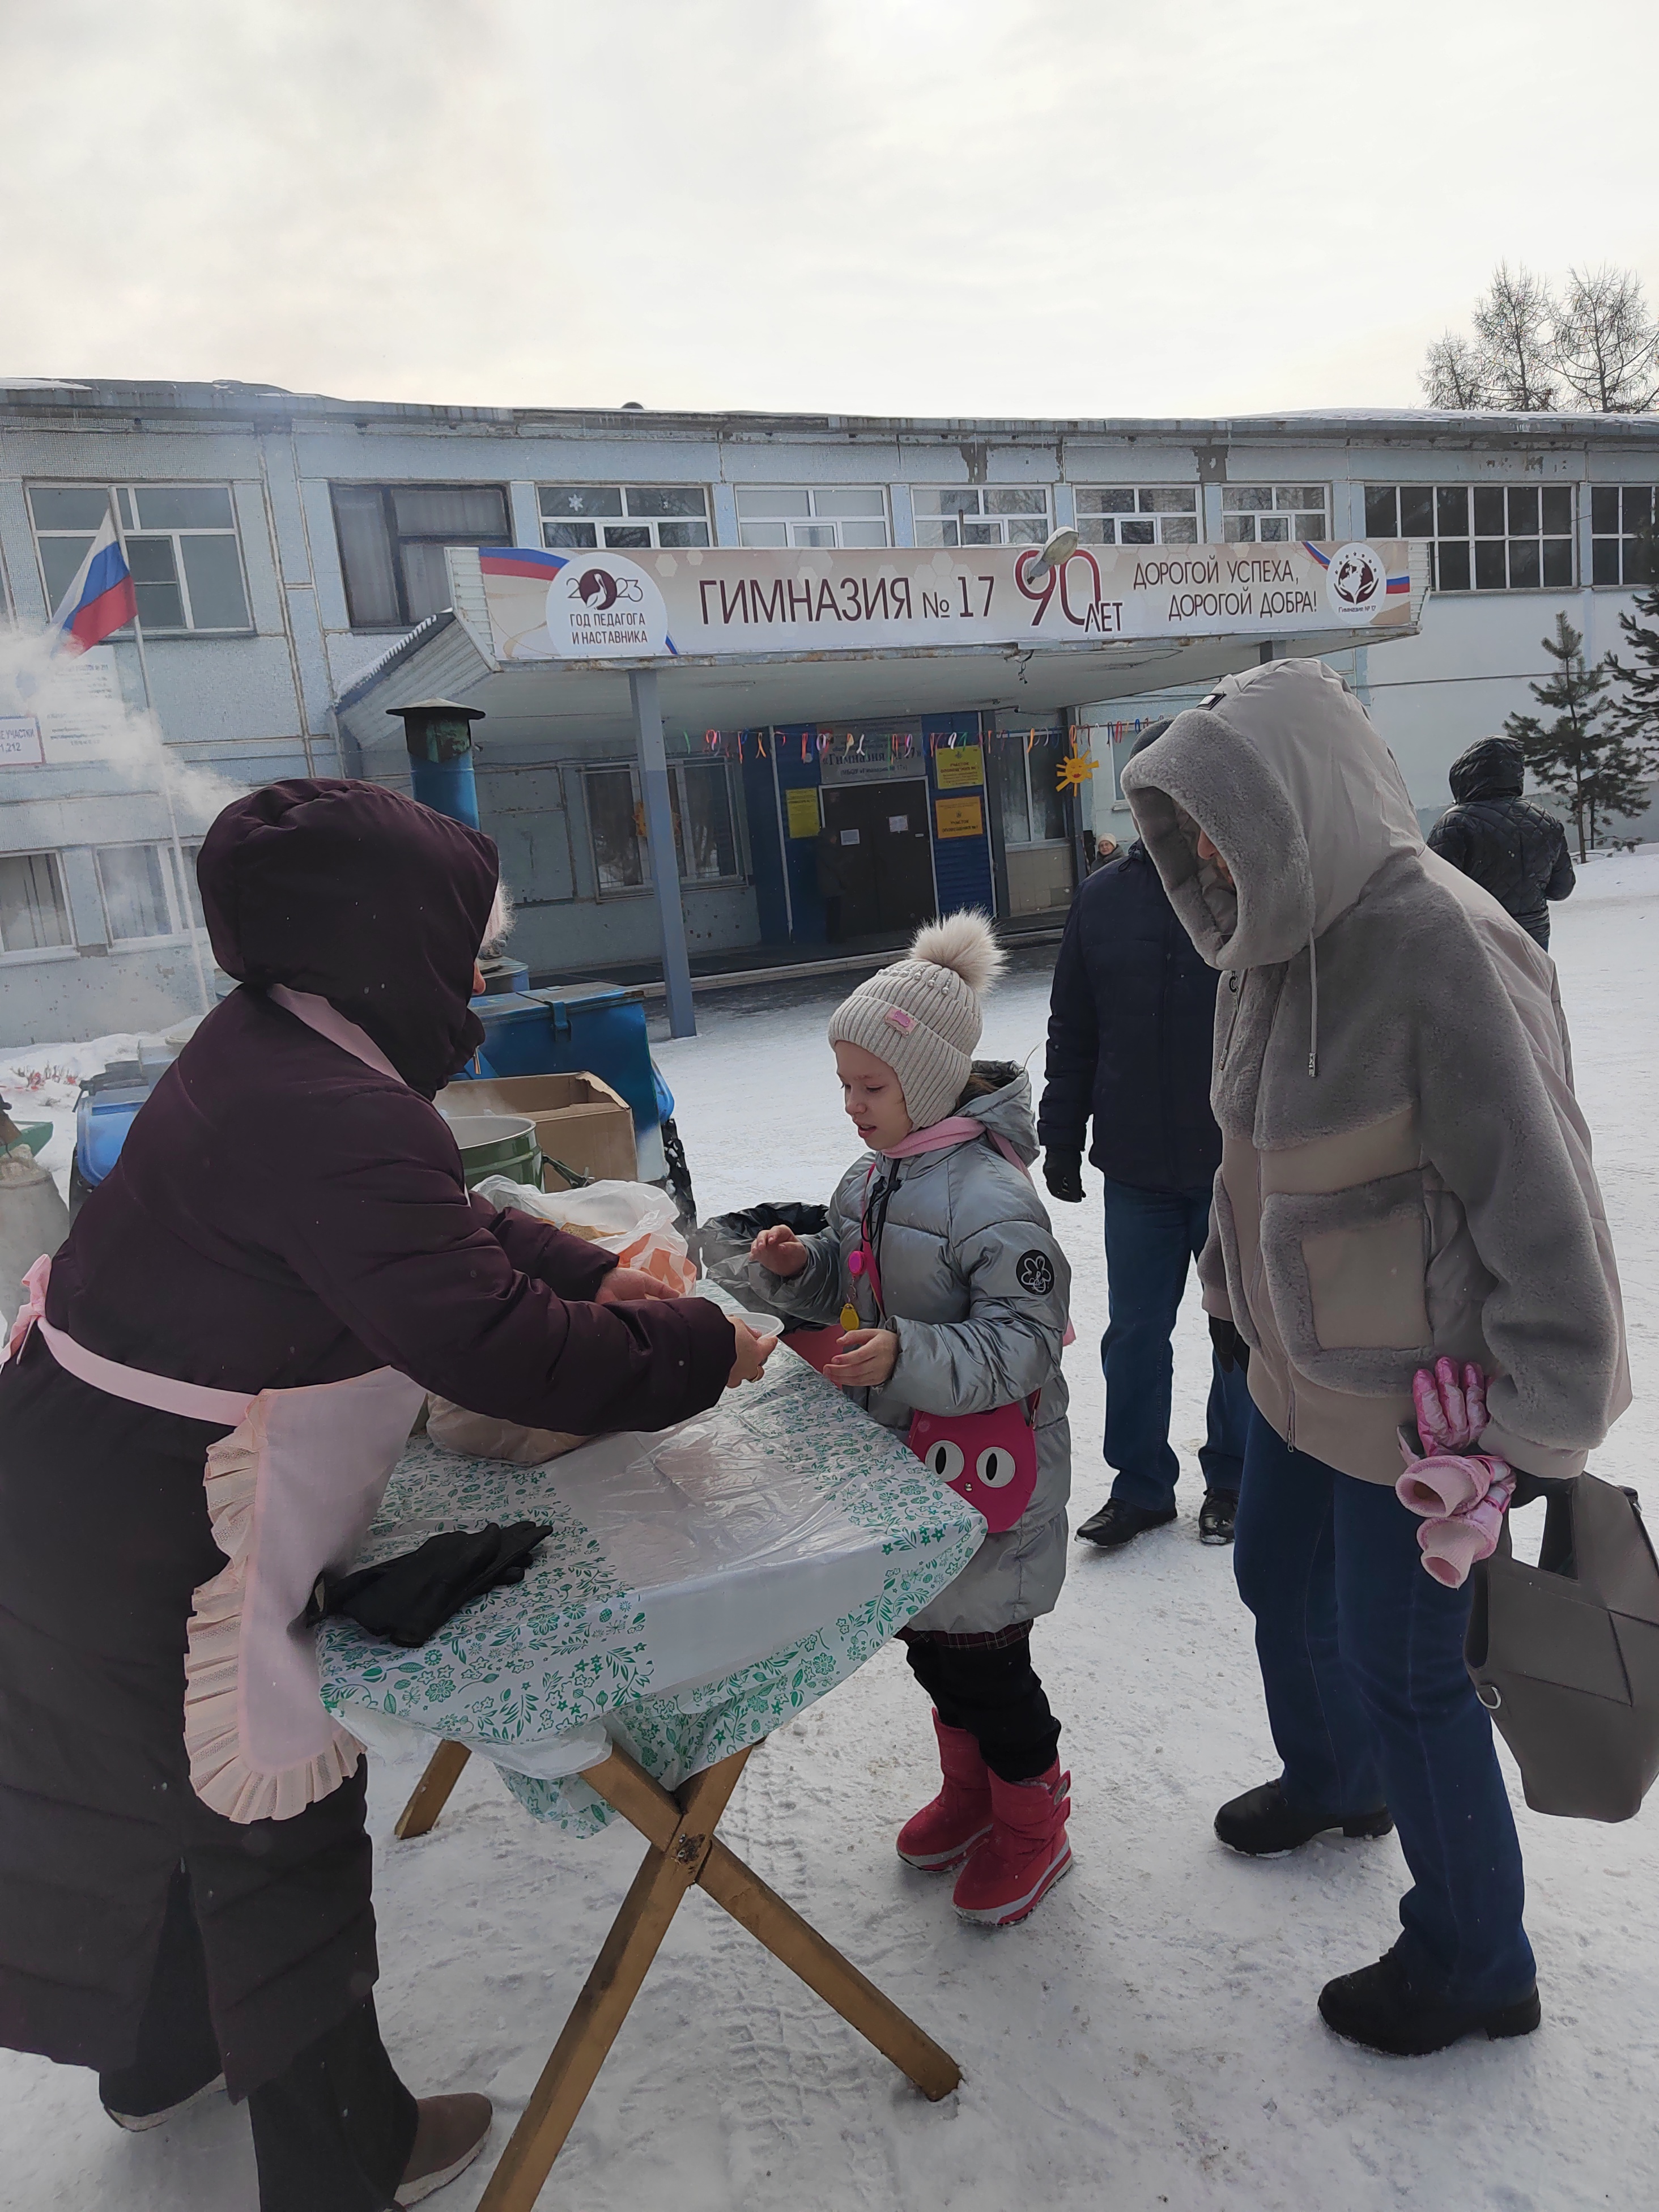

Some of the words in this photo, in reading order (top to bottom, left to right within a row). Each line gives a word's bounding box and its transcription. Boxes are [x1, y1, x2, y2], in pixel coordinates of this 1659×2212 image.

[1015, 549, 1101, 626] 90
[1134, 554, 1219, 590] ДОРОГОЙ
[1226, 559, 1299, 585] УСПЕХА,
[699, 577, 912, 625] ГИМНАЗИЯ
[922, 591, 950, 619] №
[958, 576, 994, 618] 17
[1084, 602, 1123, 633] ЛЕТ
[1168, 586, 1252, 622] ДОРОГОЙ
[1260, 590, 1317, 619] ДОБРА!
[569, 614, 591, 628] ГОД
[594, 612, 646, 627] ПЕДАГОГА
[572, 631, 580, 645] И
[581, 630, 648, 645] НАСТАВНИКА
